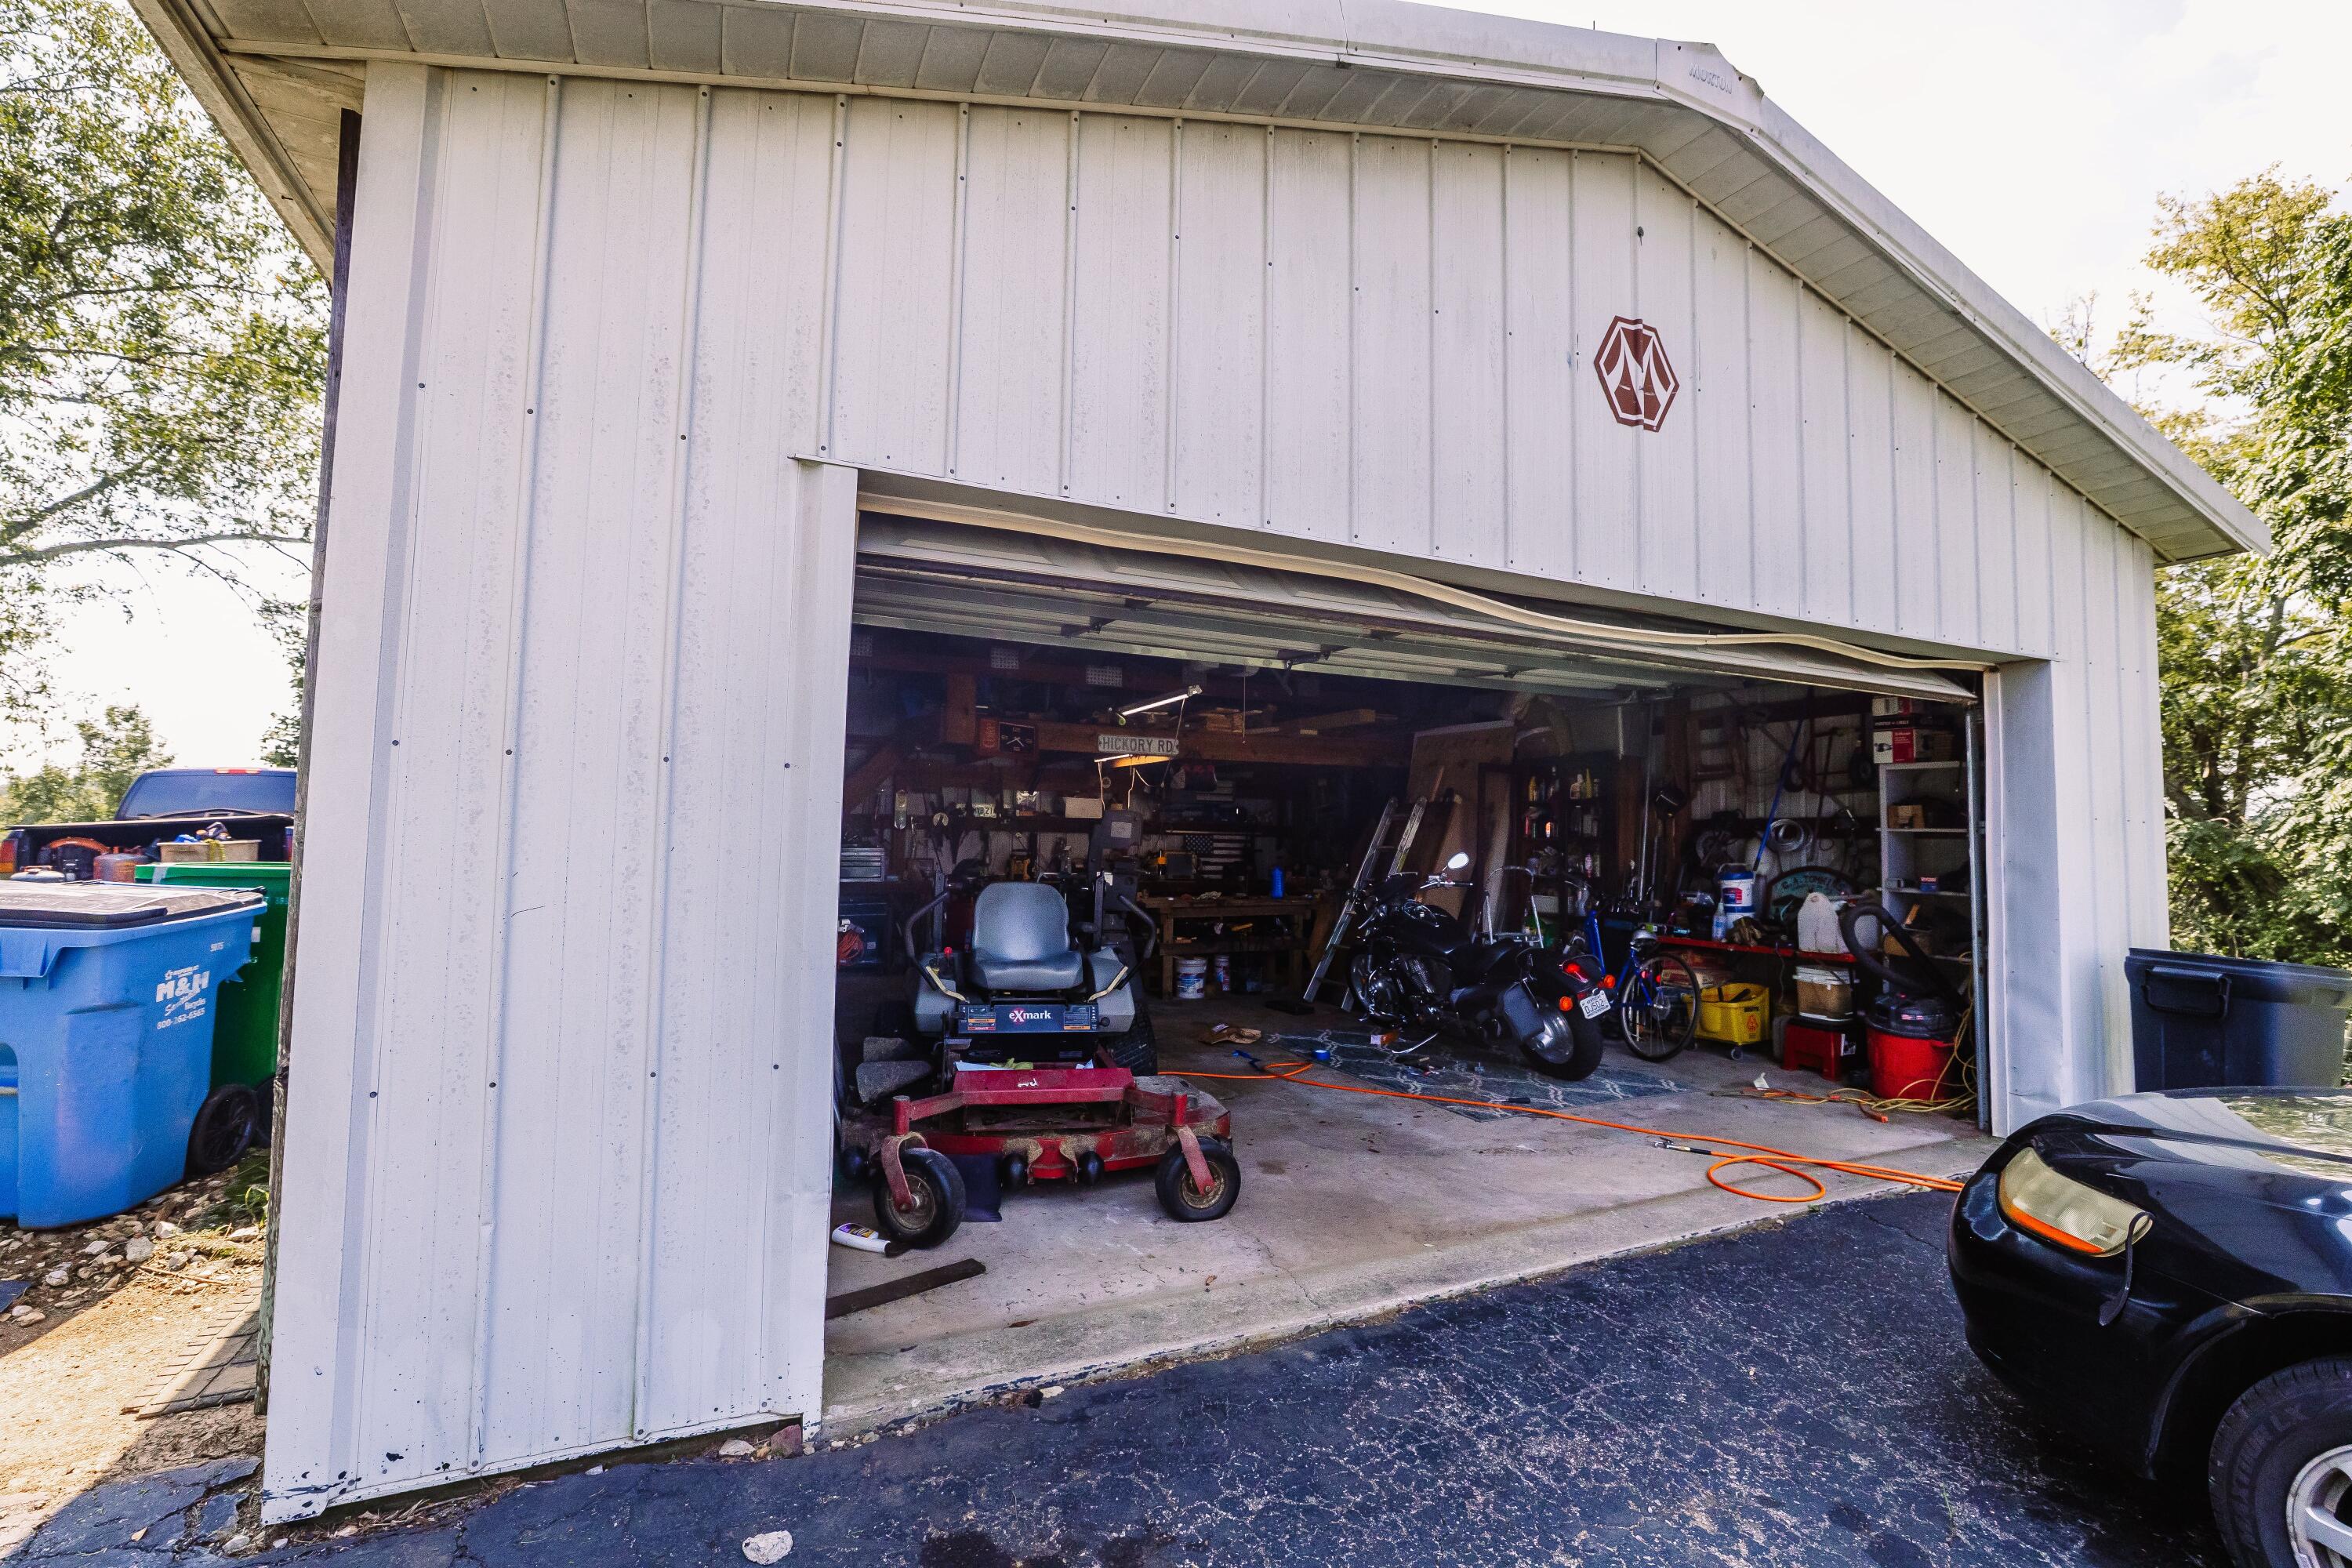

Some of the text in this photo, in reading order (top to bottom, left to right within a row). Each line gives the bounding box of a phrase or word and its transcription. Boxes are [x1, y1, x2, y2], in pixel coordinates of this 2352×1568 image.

[1102, 737, 1173, 753] HICKORY RD
[1009, 1010, 1051, 1022] eXmark
[2269, 1403, 2310, 1432] LX
